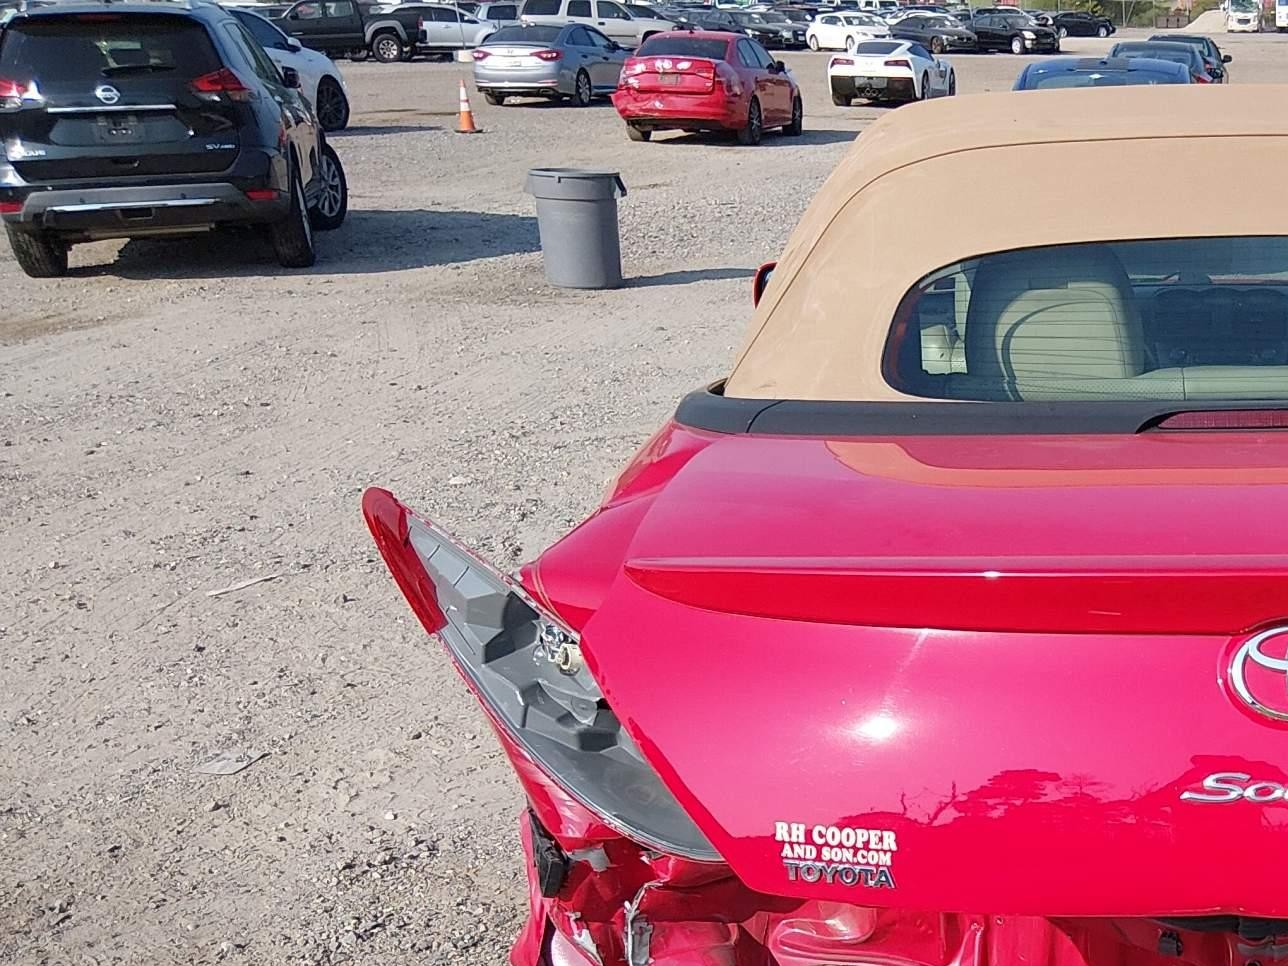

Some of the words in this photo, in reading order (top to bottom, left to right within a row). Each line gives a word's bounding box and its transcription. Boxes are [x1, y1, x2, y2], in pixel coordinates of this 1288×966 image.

[774, 821, 806, 844] RH
[812, 824, 898, 851] COOPER
[781, 842, 817, 859] AND
[821, 847, 892, 866] SON.COM
[783, 859, 896, 889] TOYOTA
